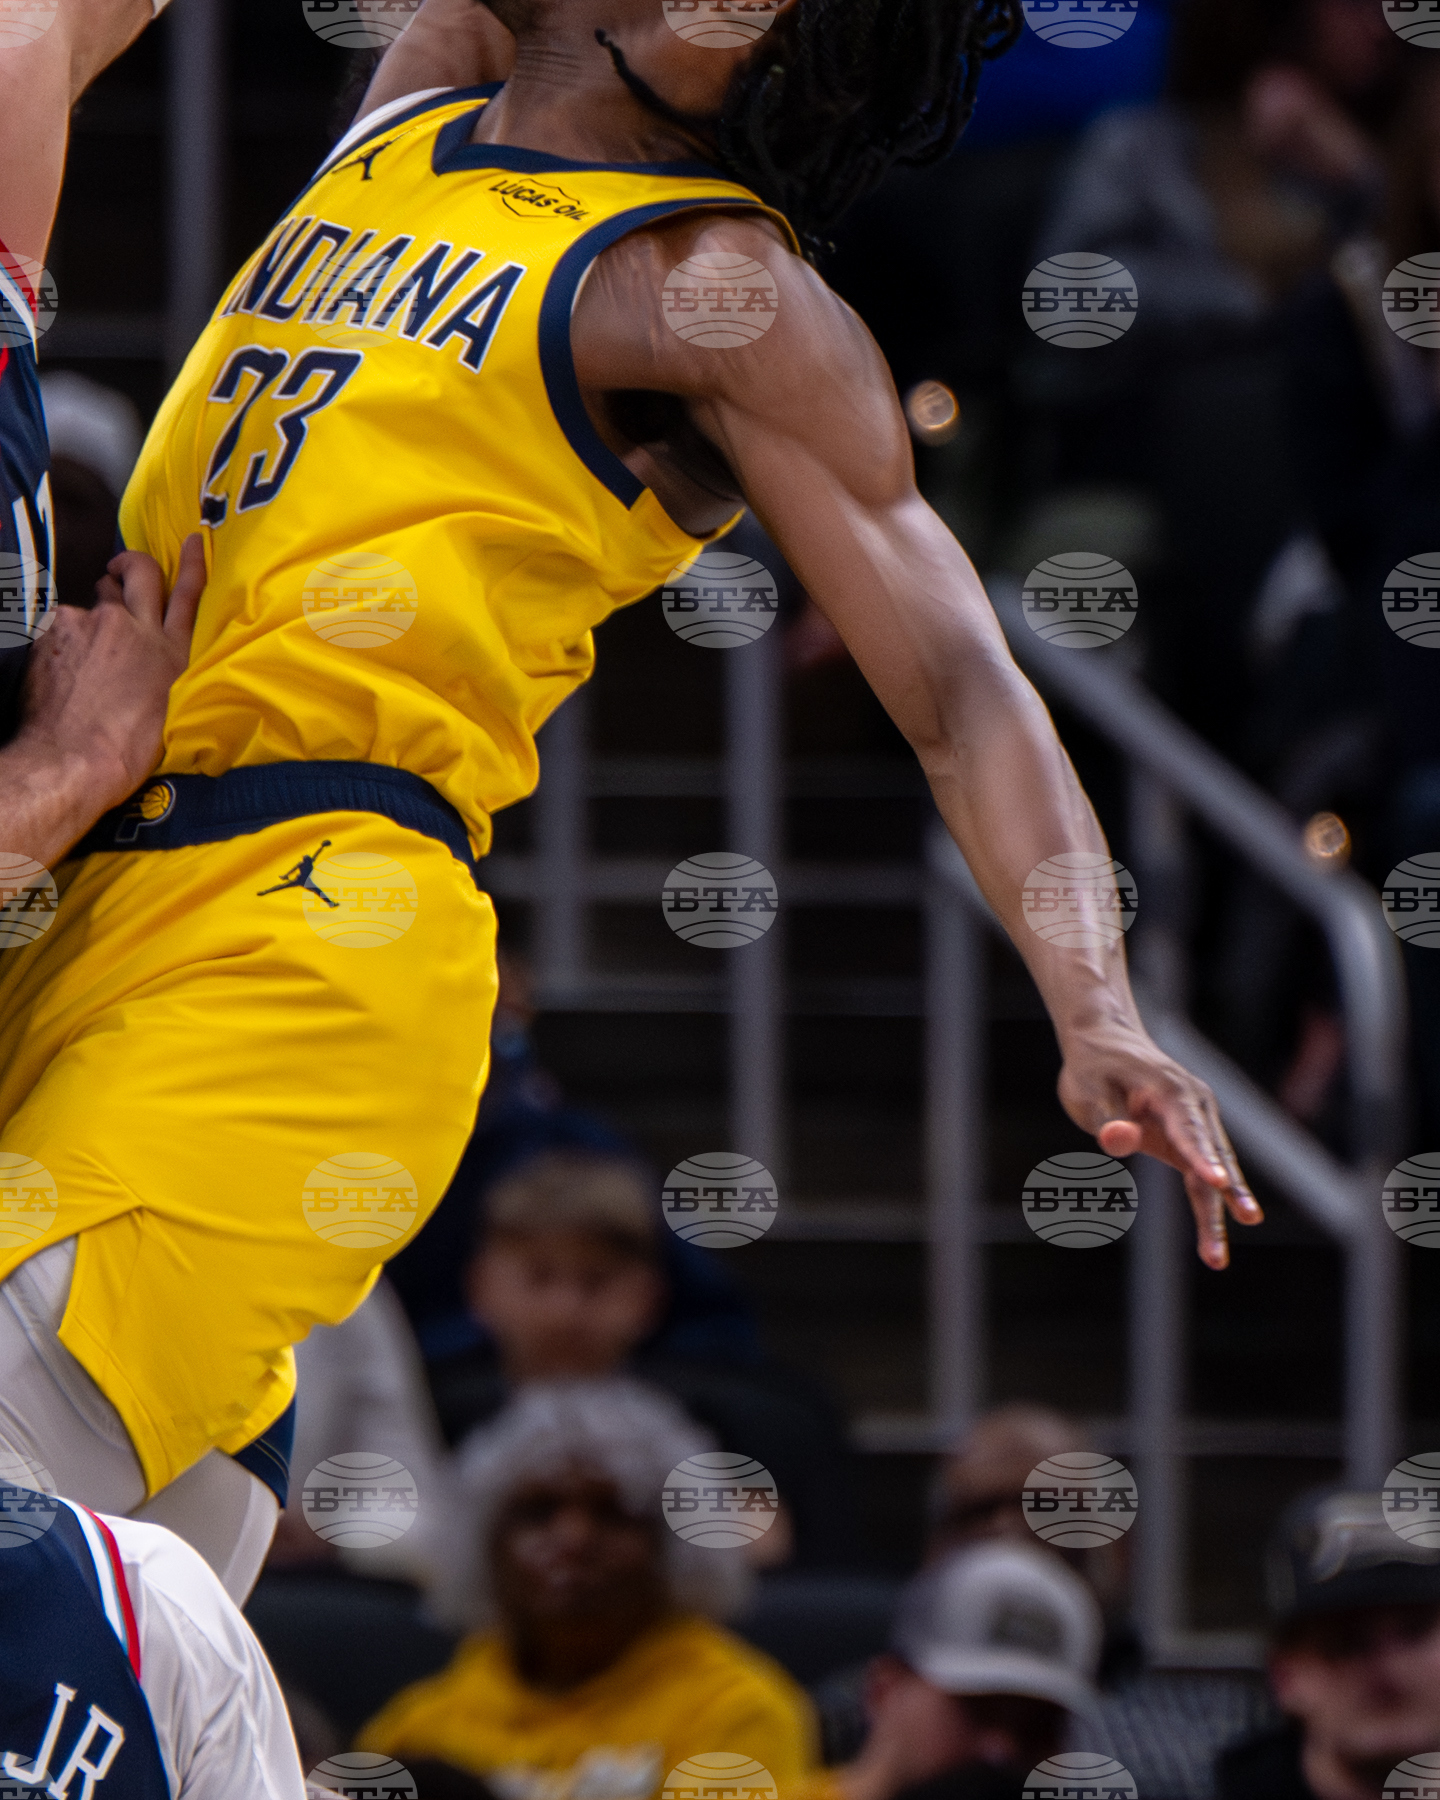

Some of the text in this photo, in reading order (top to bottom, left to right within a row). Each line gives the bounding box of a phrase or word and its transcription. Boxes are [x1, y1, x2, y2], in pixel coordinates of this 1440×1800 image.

[488, 180, 590, 221] LUCAS OIL
[218, 214, 527, 374] NDIANA
[199, 344, 365, 529] 23
